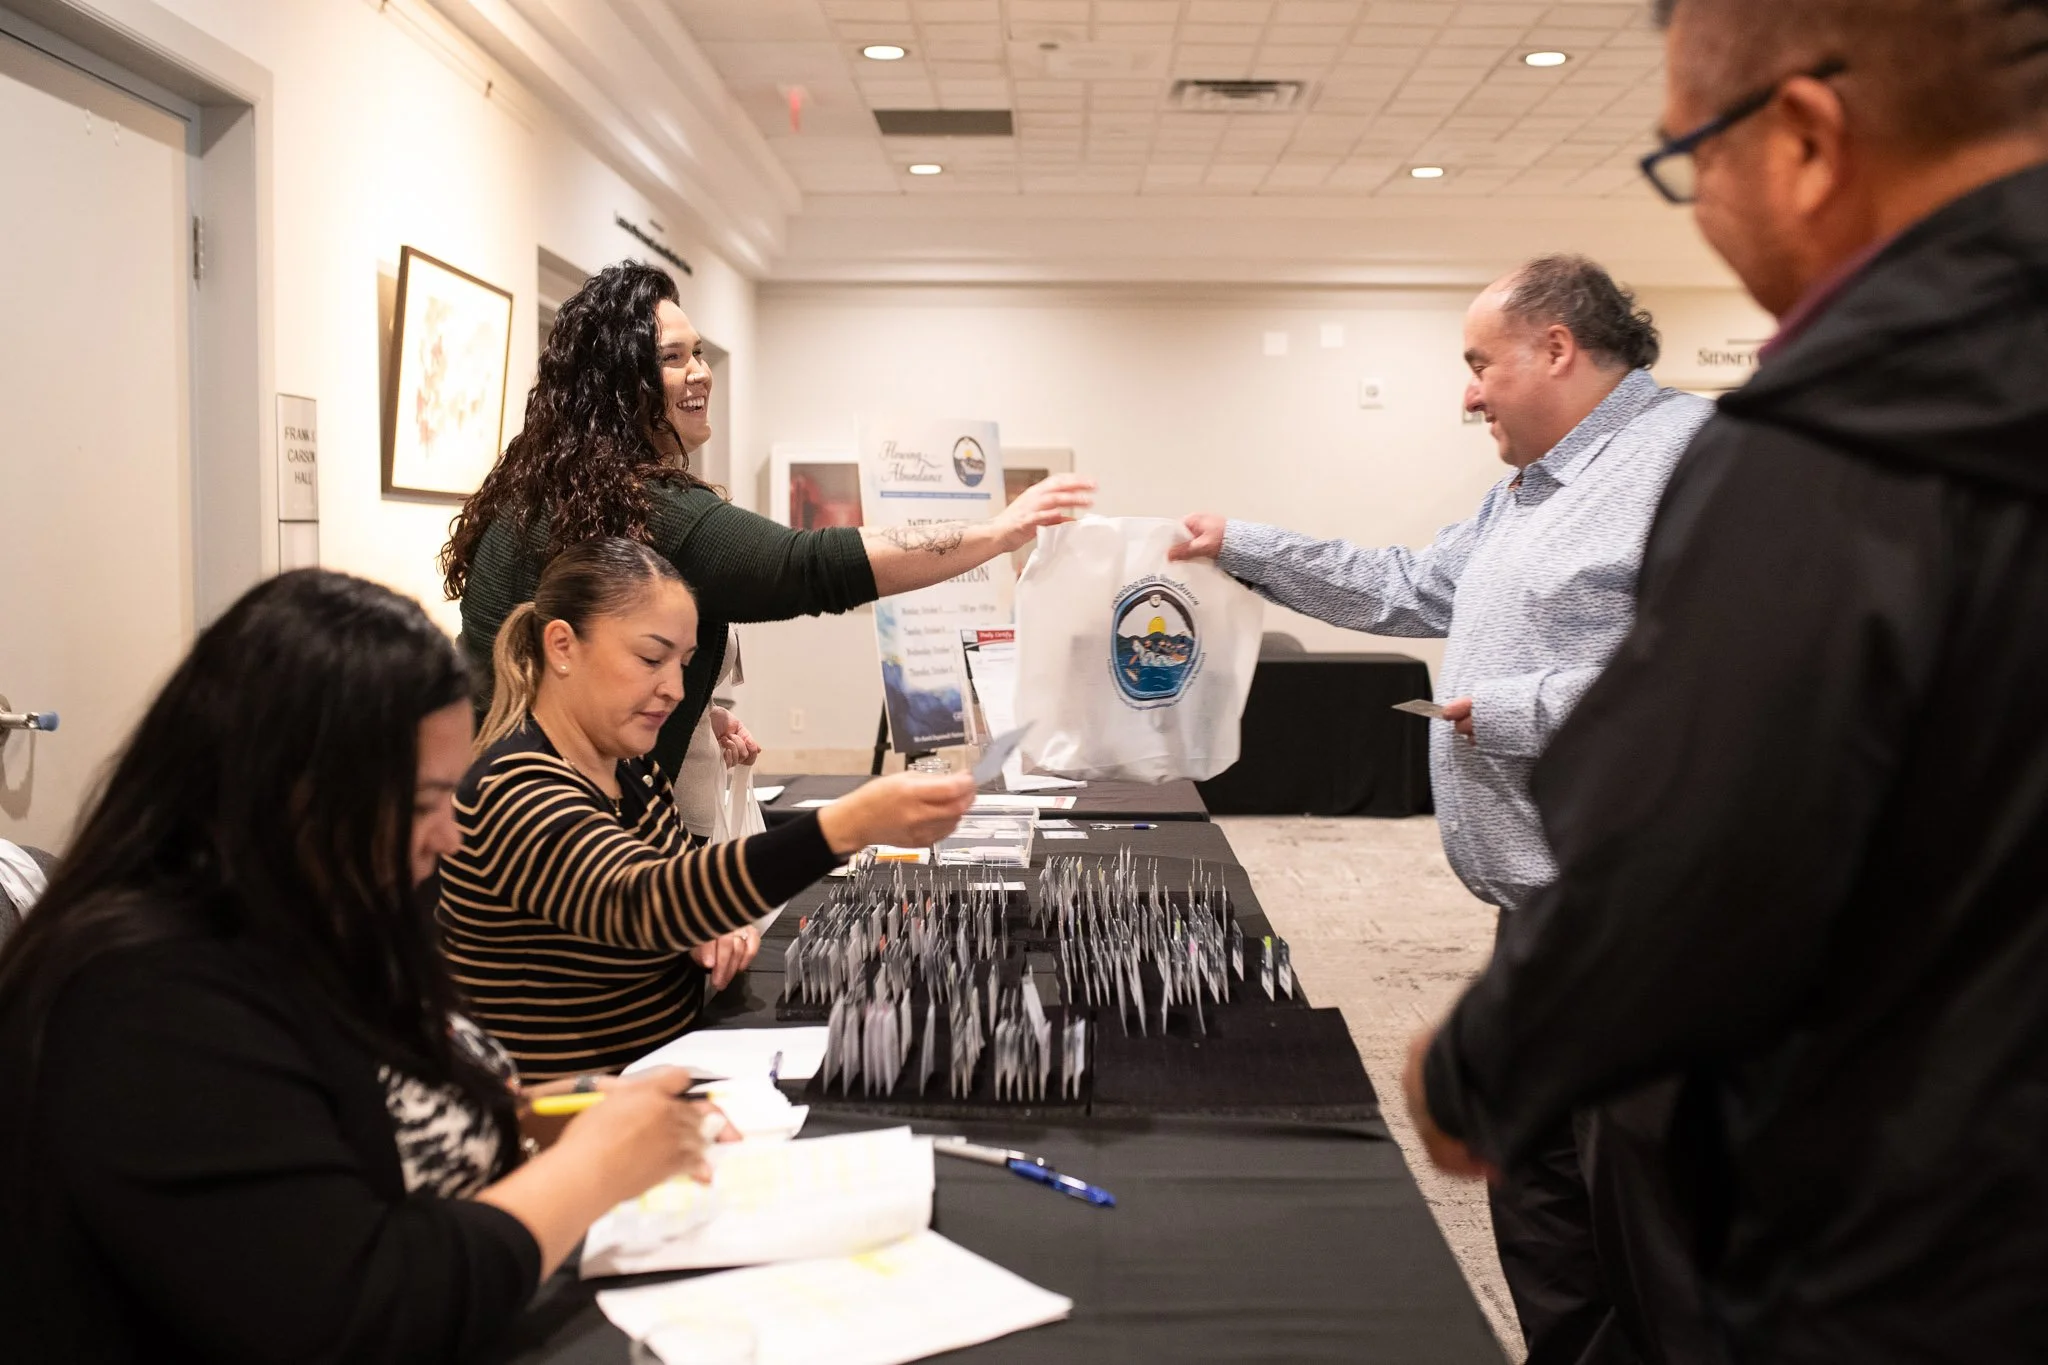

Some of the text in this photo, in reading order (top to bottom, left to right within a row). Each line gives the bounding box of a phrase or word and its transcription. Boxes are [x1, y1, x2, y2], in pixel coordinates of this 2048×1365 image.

[284, 426, 309, 441] FRANK
[287, 448, 315, 463] CARSON
[294, 471, 312, 485] HALL
[880, 463, 943, 483] Abundance
